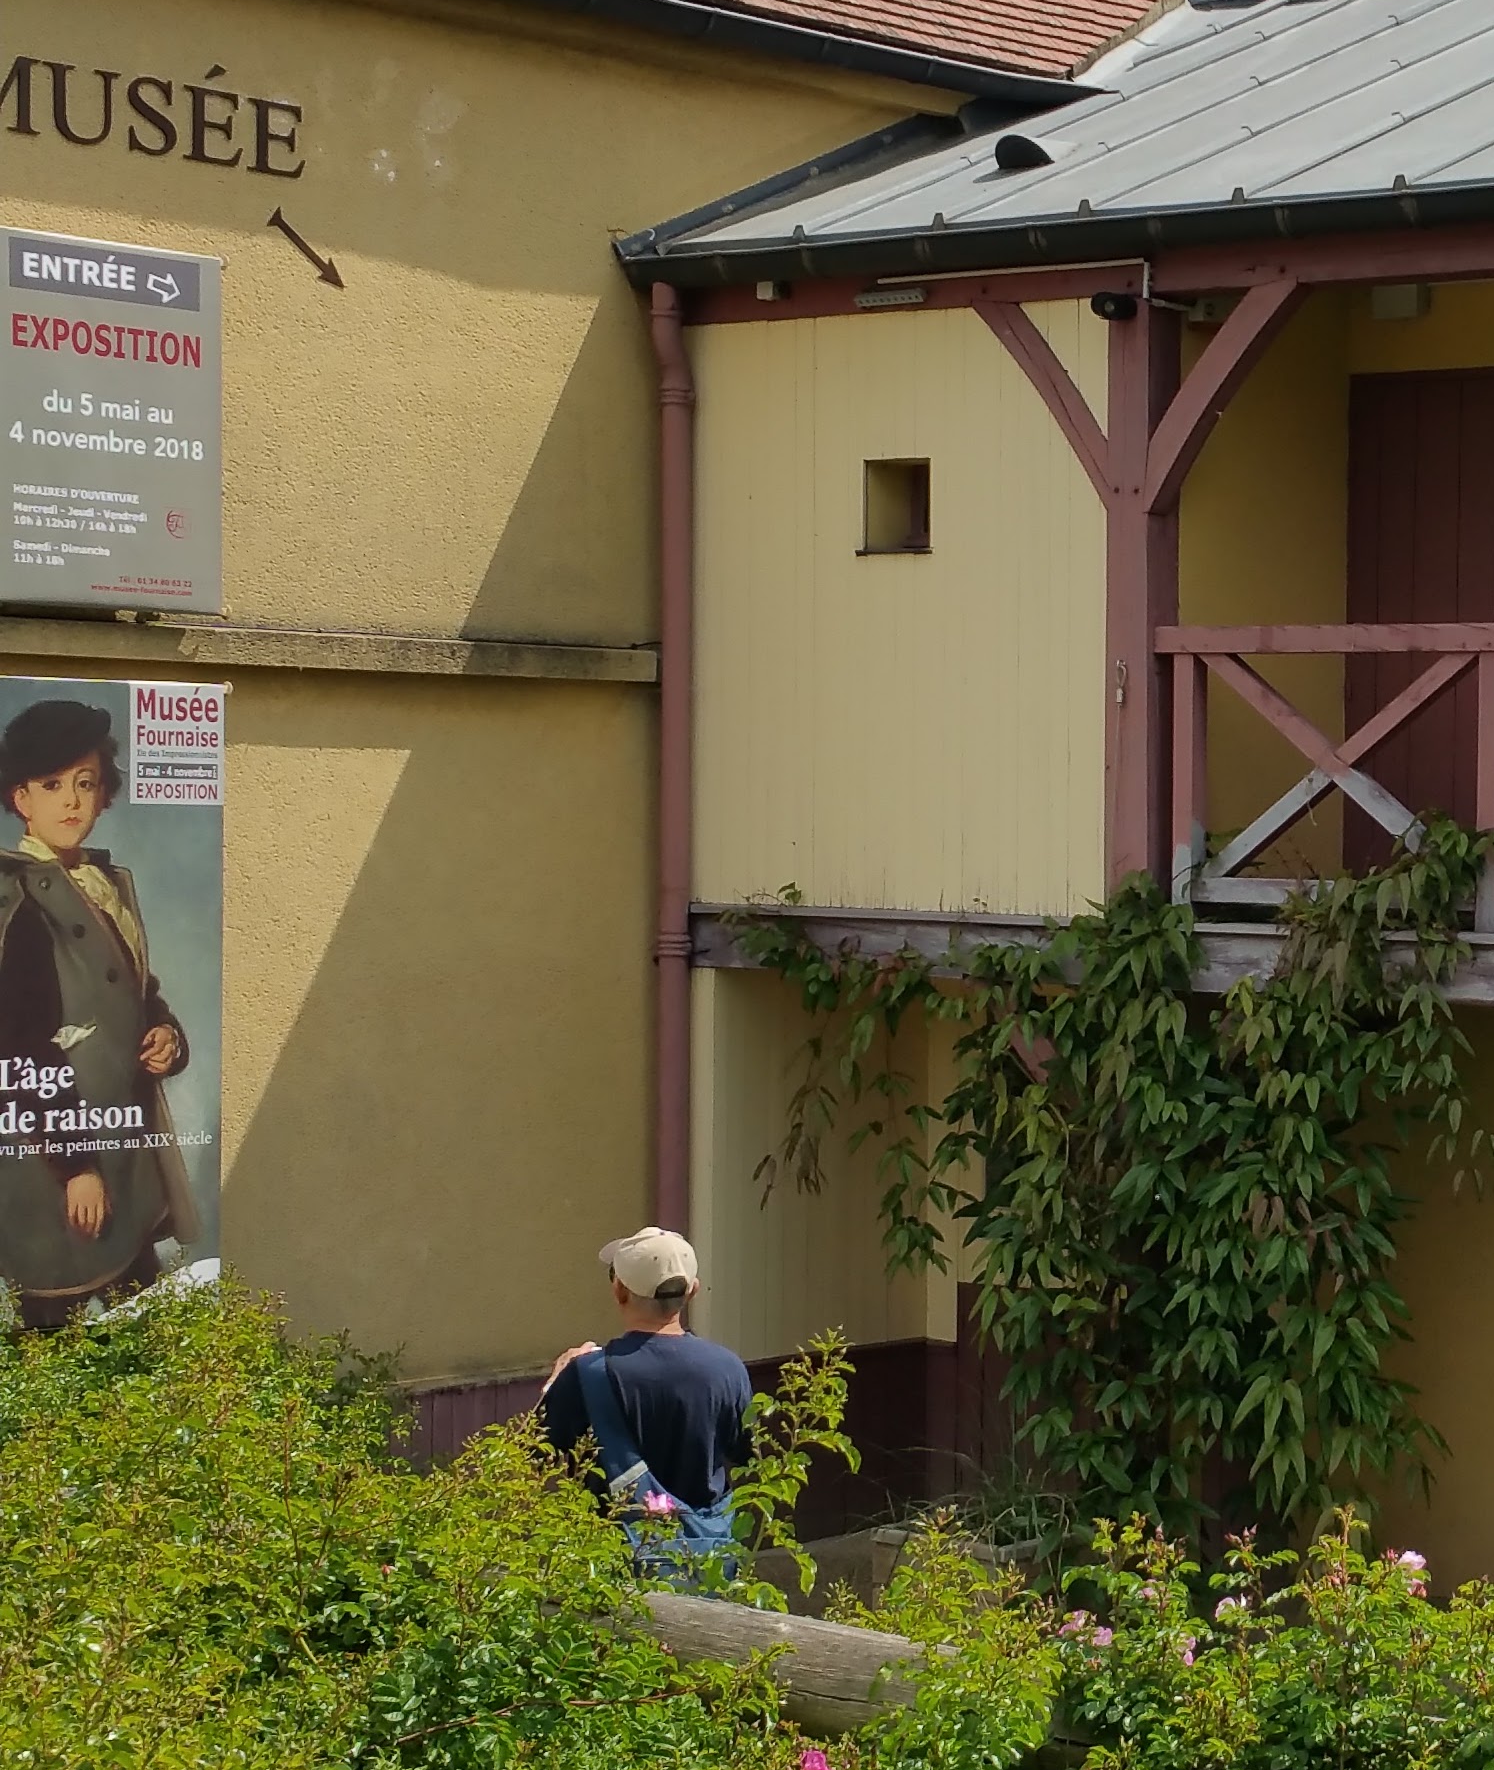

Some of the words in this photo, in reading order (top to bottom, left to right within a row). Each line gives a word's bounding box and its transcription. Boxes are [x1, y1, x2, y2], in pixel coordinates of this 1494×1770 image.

[22, 251, 137, 292] ENTRÉE
[12, 313, 201, 368] EXPOSITION
[42, 389, 73, 414] du
[79, 392, 94, 416] 5
[100, 399, 141, 421] mai
[147, 405, 174, 425] au
[9, 420, 25, 443] 4
[32, 429, 147, 455] novembre
[154, 436, 204, 461] 2018
[136, 687, 219, 723] Musée
[136, 725, 219, 748] Fournaise
[136, 782, 218, 800] EXPOSITION
[0, 1056, 75, 1099] L'âge
[0, 1100, 36, 1135] de
[43, 1099, 145, 1133] raison
[18, 1142, 42, 1160] par
[44, 1138, 63, 1154] les
[66, 1137, 121, 1157] peintres
[123, 1139, 140, 1149] au
[176, 1130, 213, 1146] siècle
